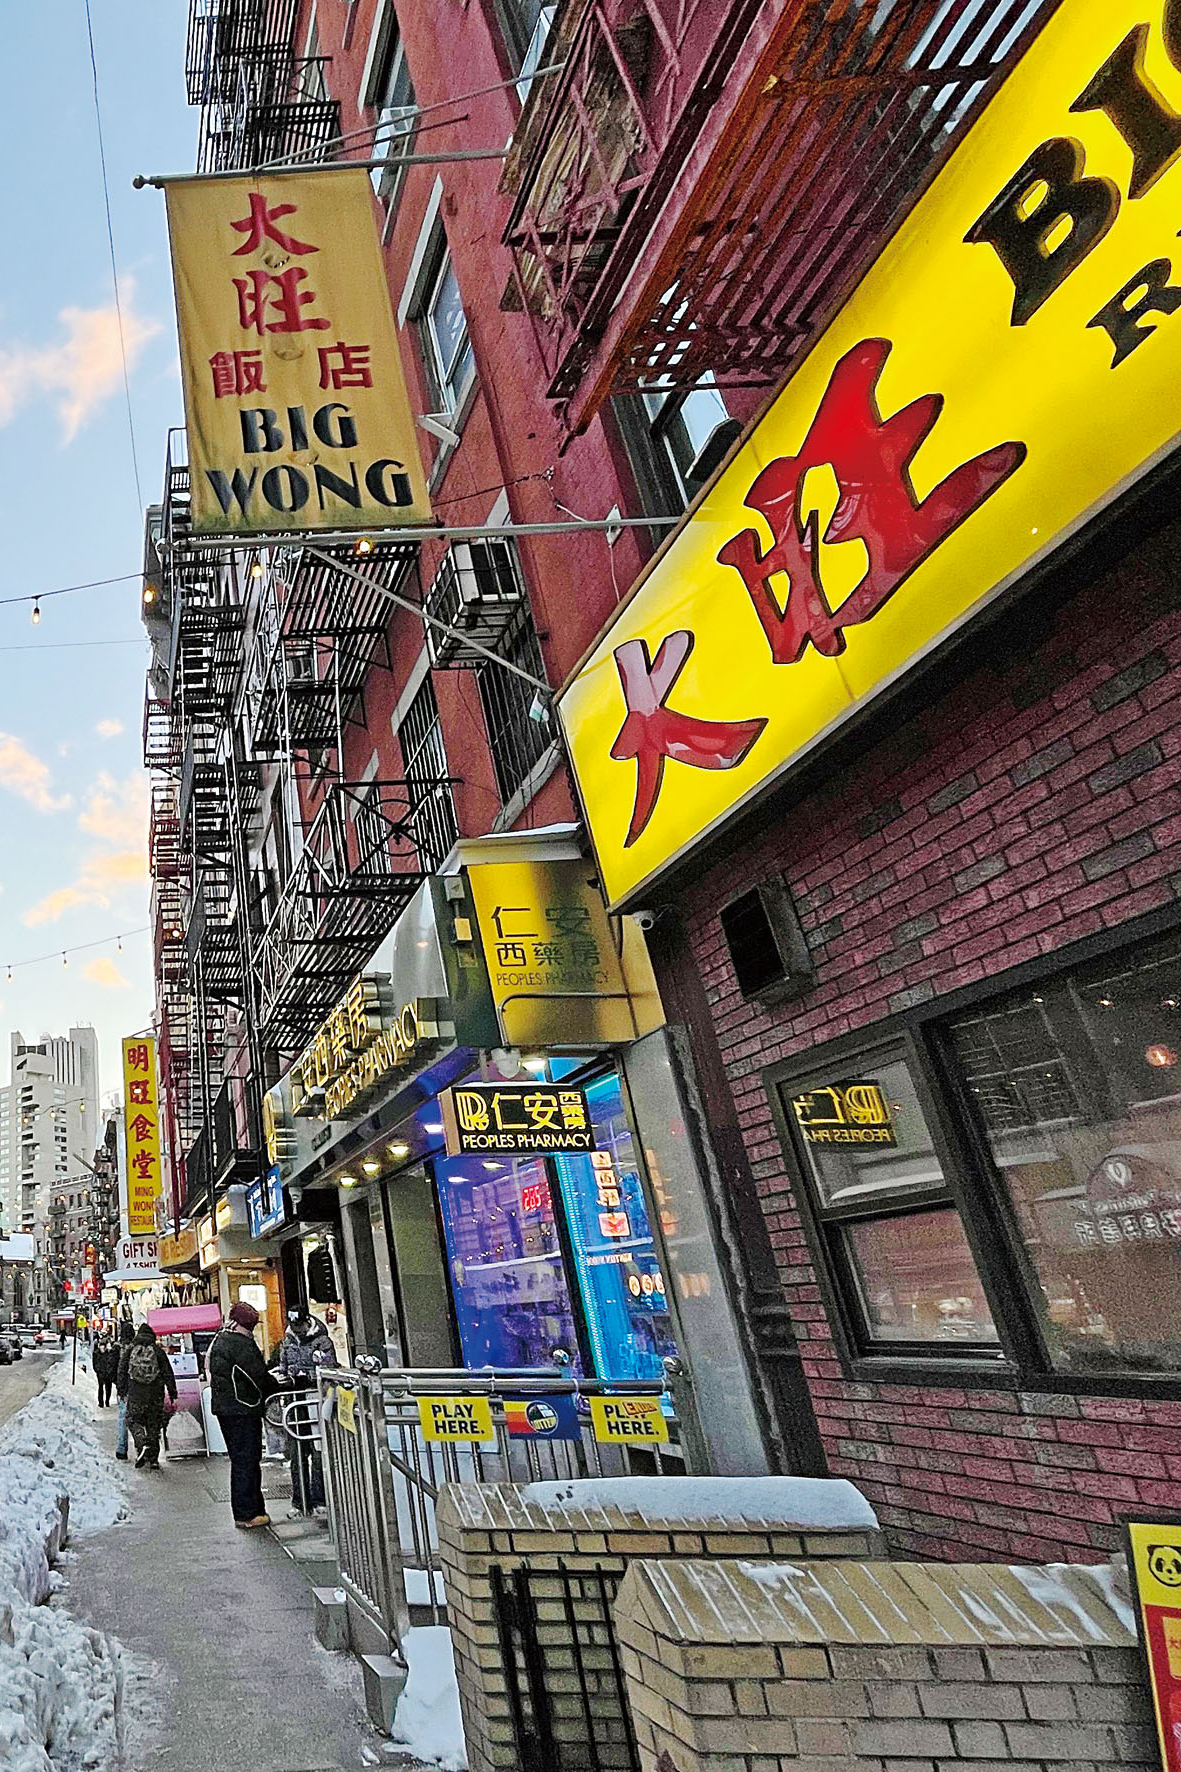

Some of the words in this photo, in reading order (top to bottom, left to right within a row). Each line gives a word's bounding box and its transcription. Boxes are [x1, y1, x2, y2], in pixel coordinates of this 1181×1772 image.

[963, 0, 1181, 327] BI
[230, 193, 331, 336] 大旺
[1086, 225, 1181, 370] R
[208, 342, 375, 399] 飯店
[239, 402, 357, 455] BIG
[205, 458, 415, 517] WONG
[491, 906, 593, 938] 仁安
[496, 972, 542, 986] PEOPLES
[127, 1044, 156, 1179] 明旺食堂
[462, 1135, 515, 1148] PEOPLES
[518, 1134, 591, 1147] PHARMACY
[134, 1186, 154, 1196] MING
[123, 1242, 144, 1258] GIFT
[431, 1404, 473, 1418] PLAY
[603, 1404, 646, 1418] PL
[435, 1420, 485, 1434] HERE.
[607, 1421, 659, 1435] HERE.
